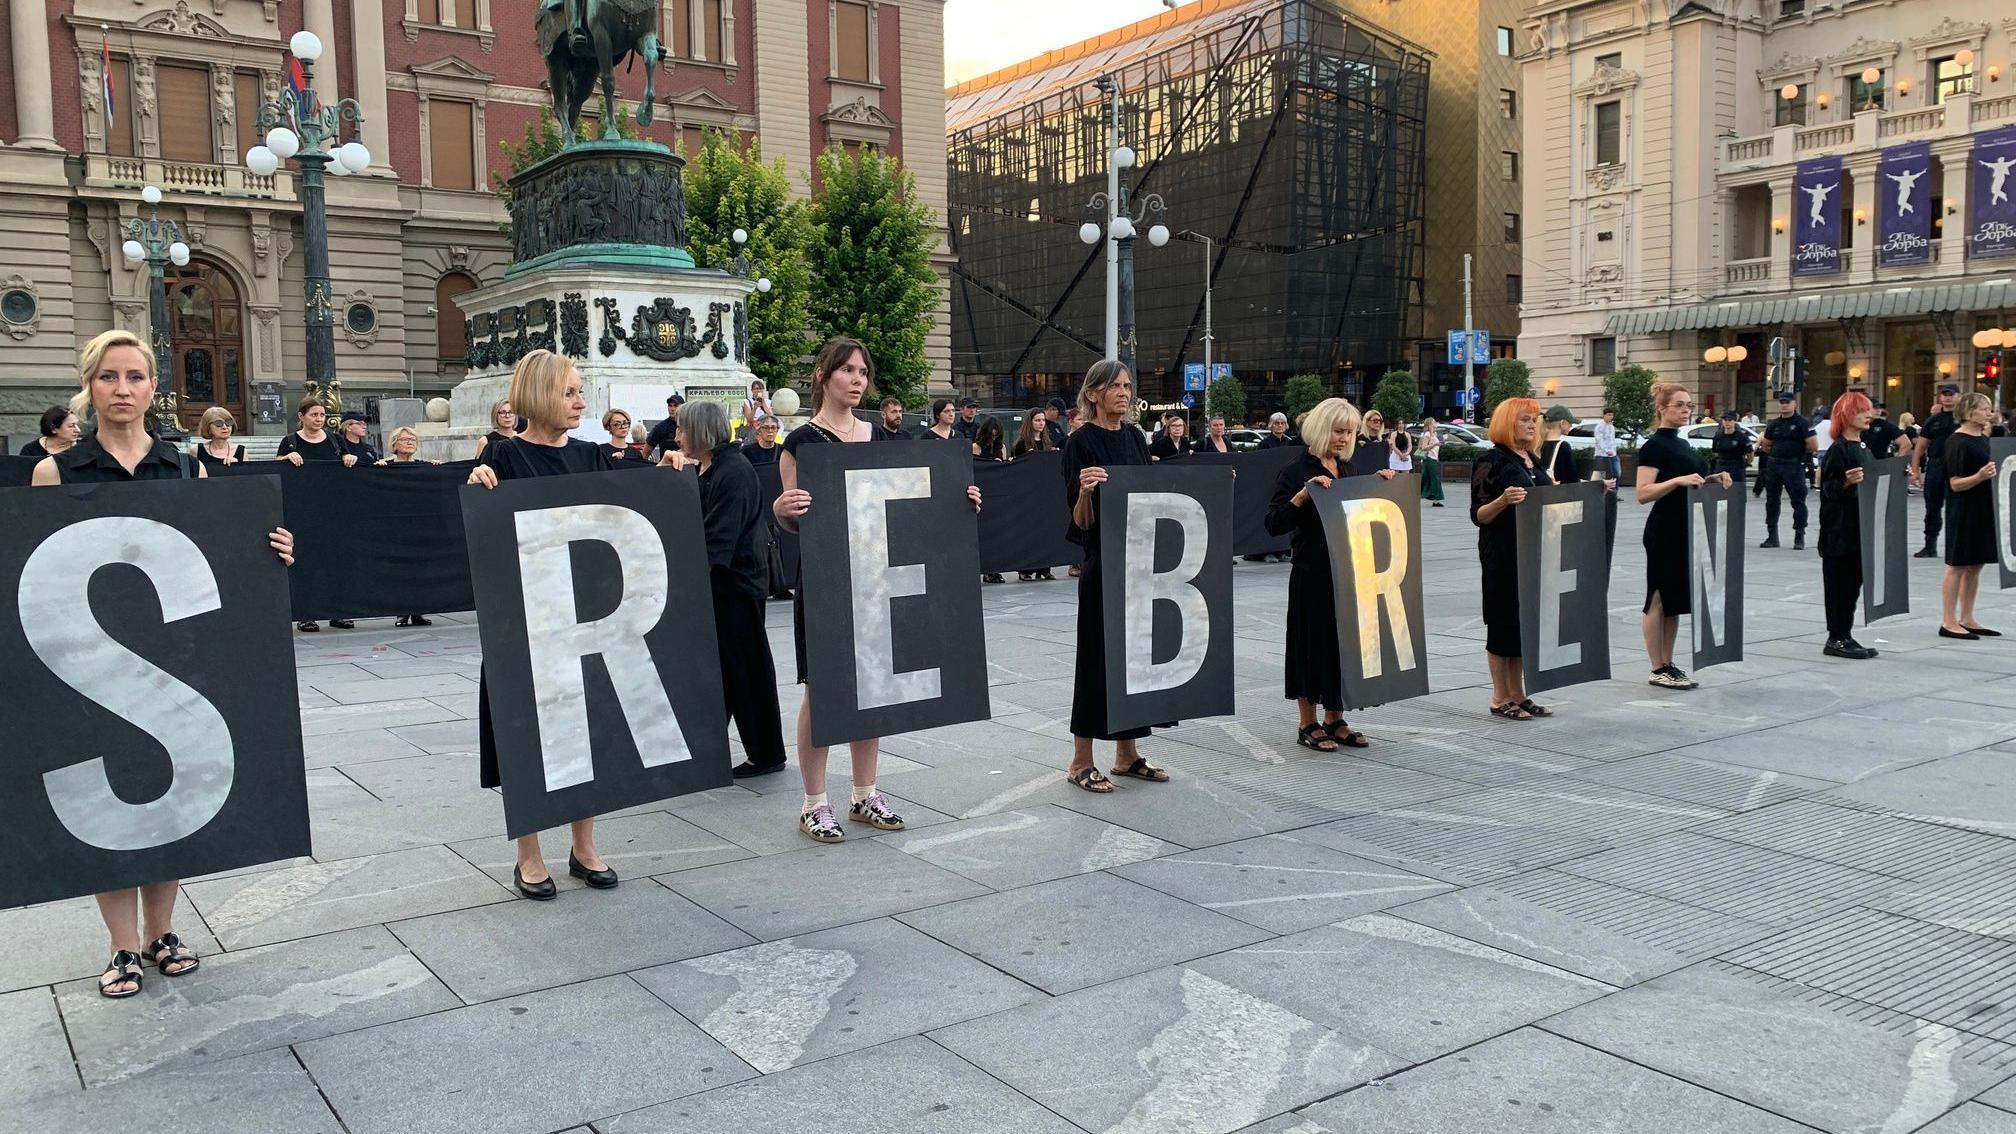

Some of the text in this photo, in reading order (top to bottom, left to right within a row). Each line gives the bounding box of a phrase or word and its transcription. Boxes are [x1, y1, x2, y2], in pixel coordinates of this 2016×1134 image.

[1882, 232, 1928, 252] Зорба
[514, 504, 692, 793] R
[844, 466, 942, 710] E
[1125, 492, 1210, 695] B
[1341, 498, 1416, 680] R
[1539, 500, 1584, 672] E
[1693, 500, 1728, 654] N
[18, 516, 235, 851] S
